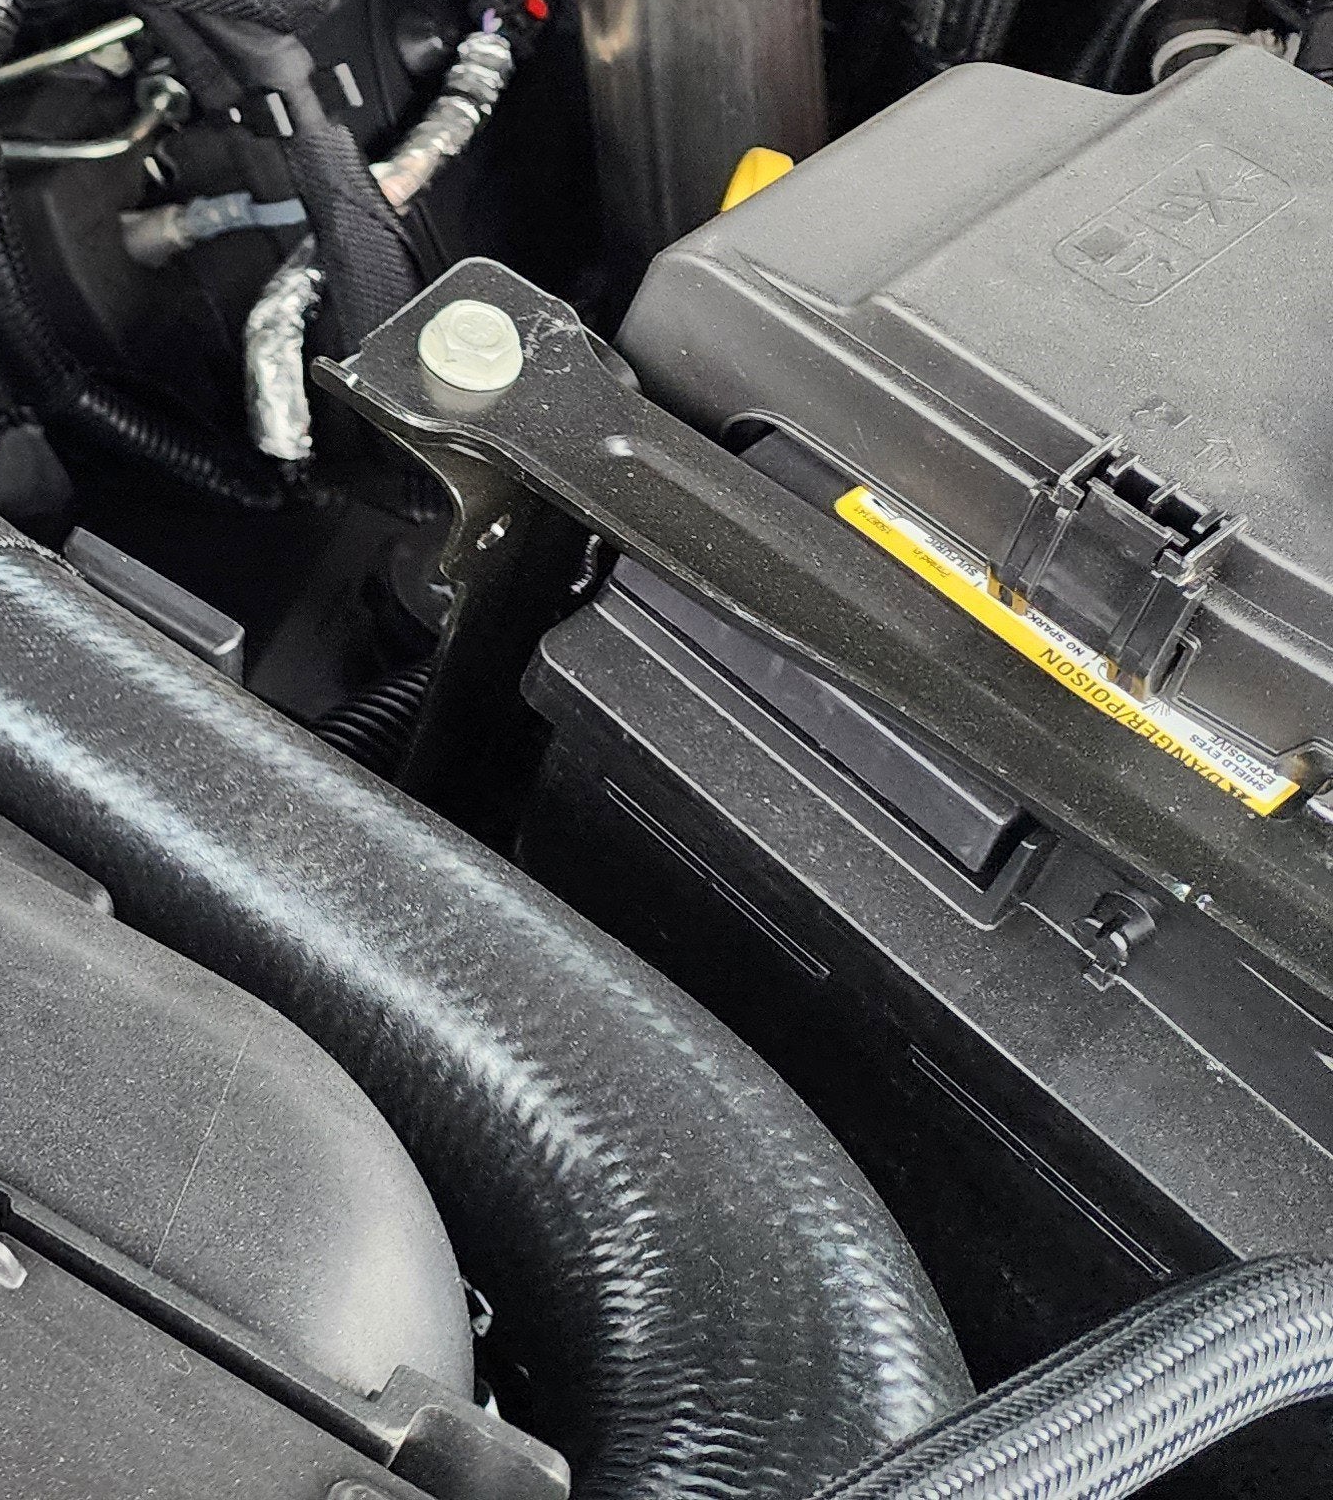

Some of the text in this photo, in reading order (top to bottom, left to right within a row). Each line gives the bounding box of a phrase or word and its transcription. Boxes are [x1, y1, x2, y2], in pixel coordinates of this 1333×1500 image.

[925, 535, 979, 577] SULFURIC
[1066, 641, 1085, 657] NO
[1189, 734, 1267, 793] SHIELD EYES
[1207, 734, 1277, 786] EXPLOSIVE
